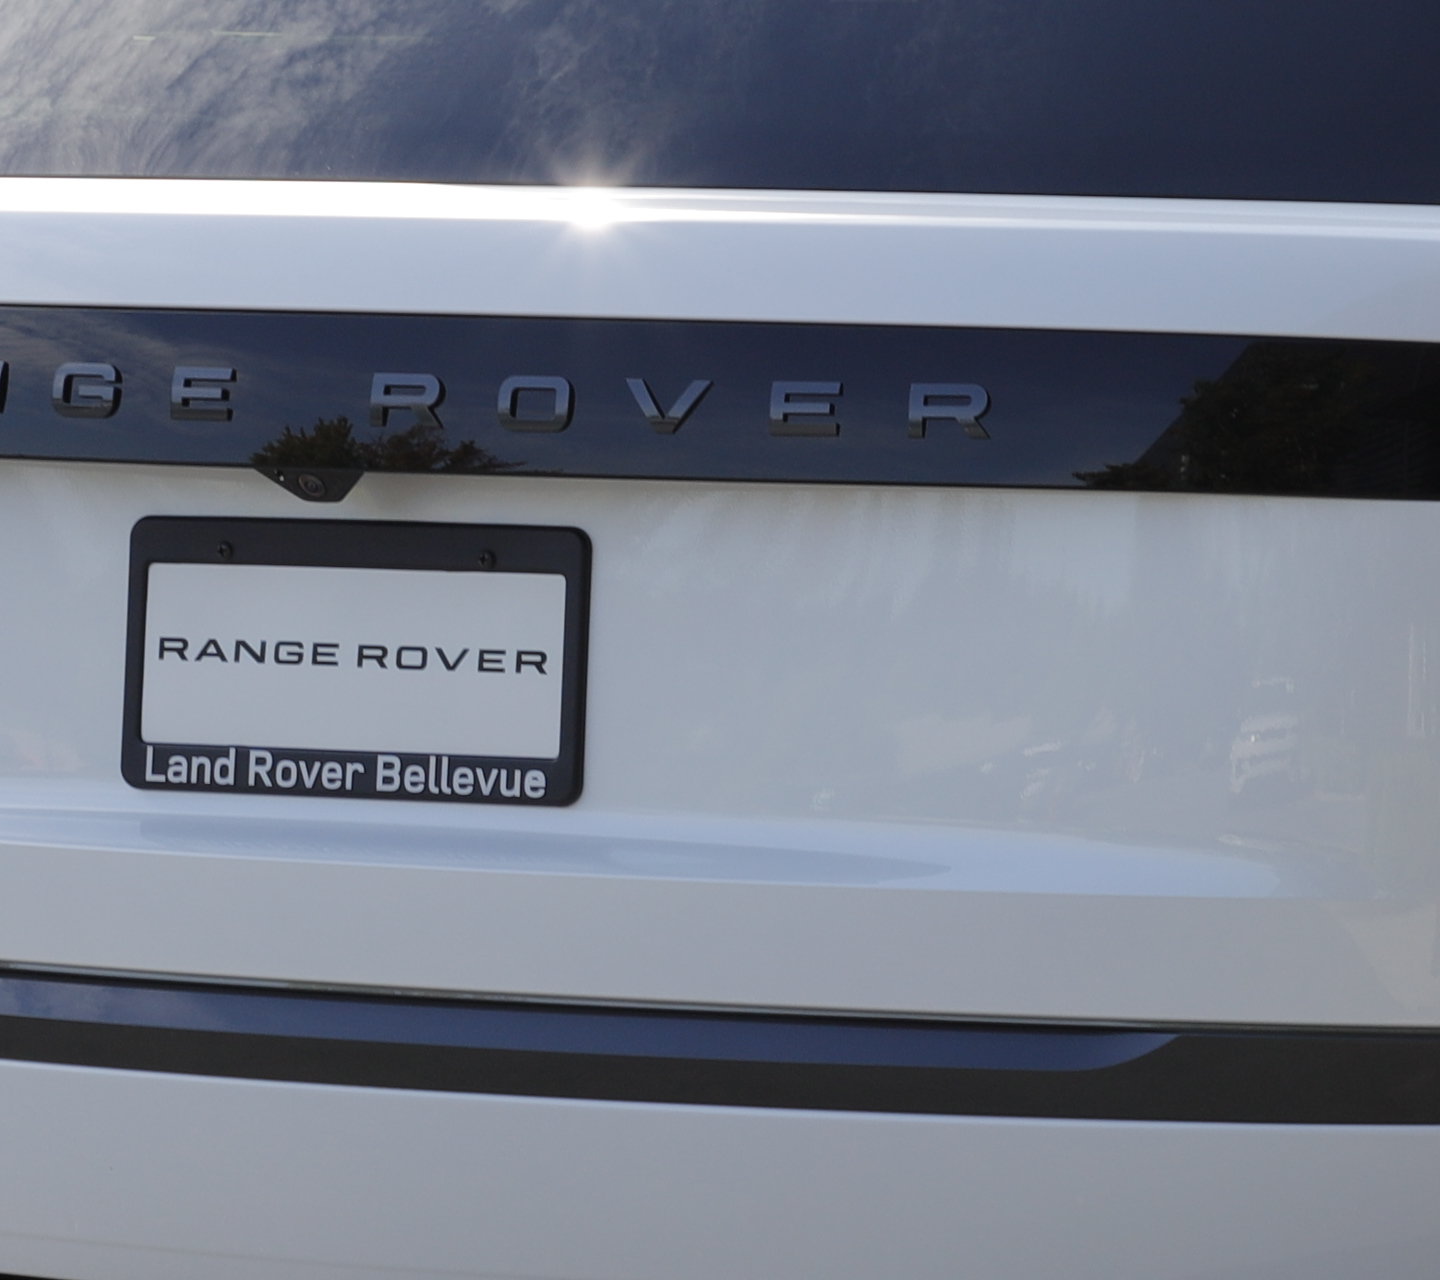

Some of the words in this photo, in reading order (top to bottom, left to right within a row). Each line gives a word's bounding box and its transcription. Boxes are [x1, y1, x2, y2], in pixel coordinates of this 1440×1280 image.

[368, 371, 992, 441] ROVER
[158, 637, 340, 667] RANGE
[356, 644, 548, 675] ROVER
[144, 745, 237, 787] Land
[248, 749, 365, 792] Rover
[375, 754, 547, 799] Bellevue
